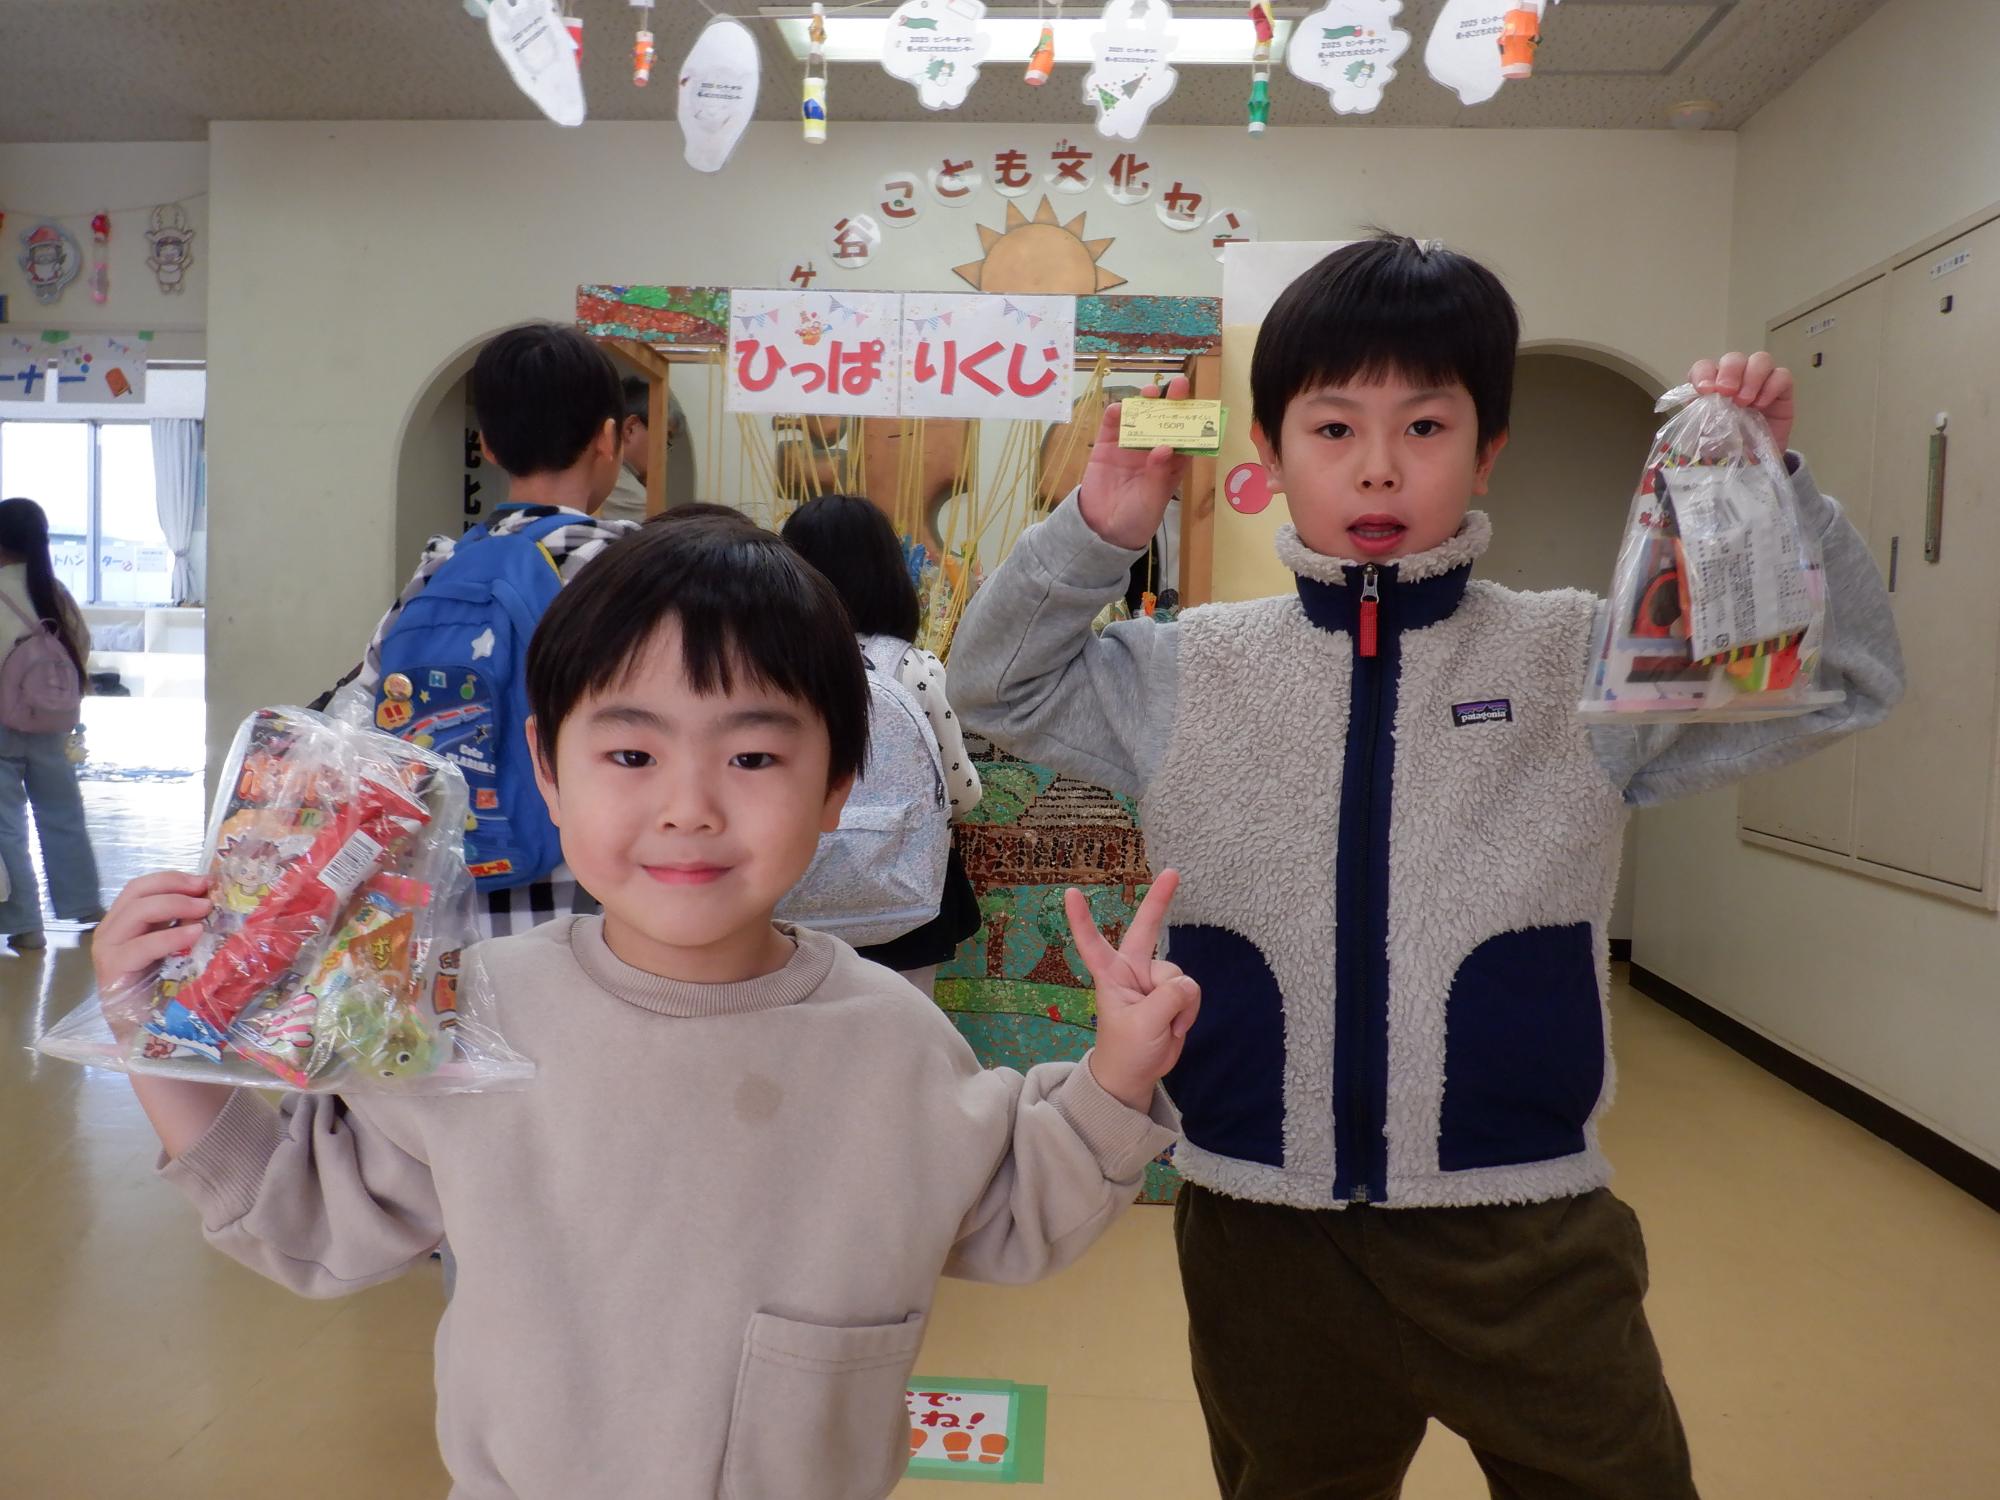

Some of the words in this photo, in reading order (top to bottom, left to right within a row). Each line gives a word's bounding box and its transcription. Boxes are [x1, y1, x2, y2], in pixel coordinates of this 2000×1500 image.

[734, 338, 1060, 398] ひっぱりくじ
[1461, 711, 1507, 723] patagonia
[909, 1411, 986, 1430] ね!
